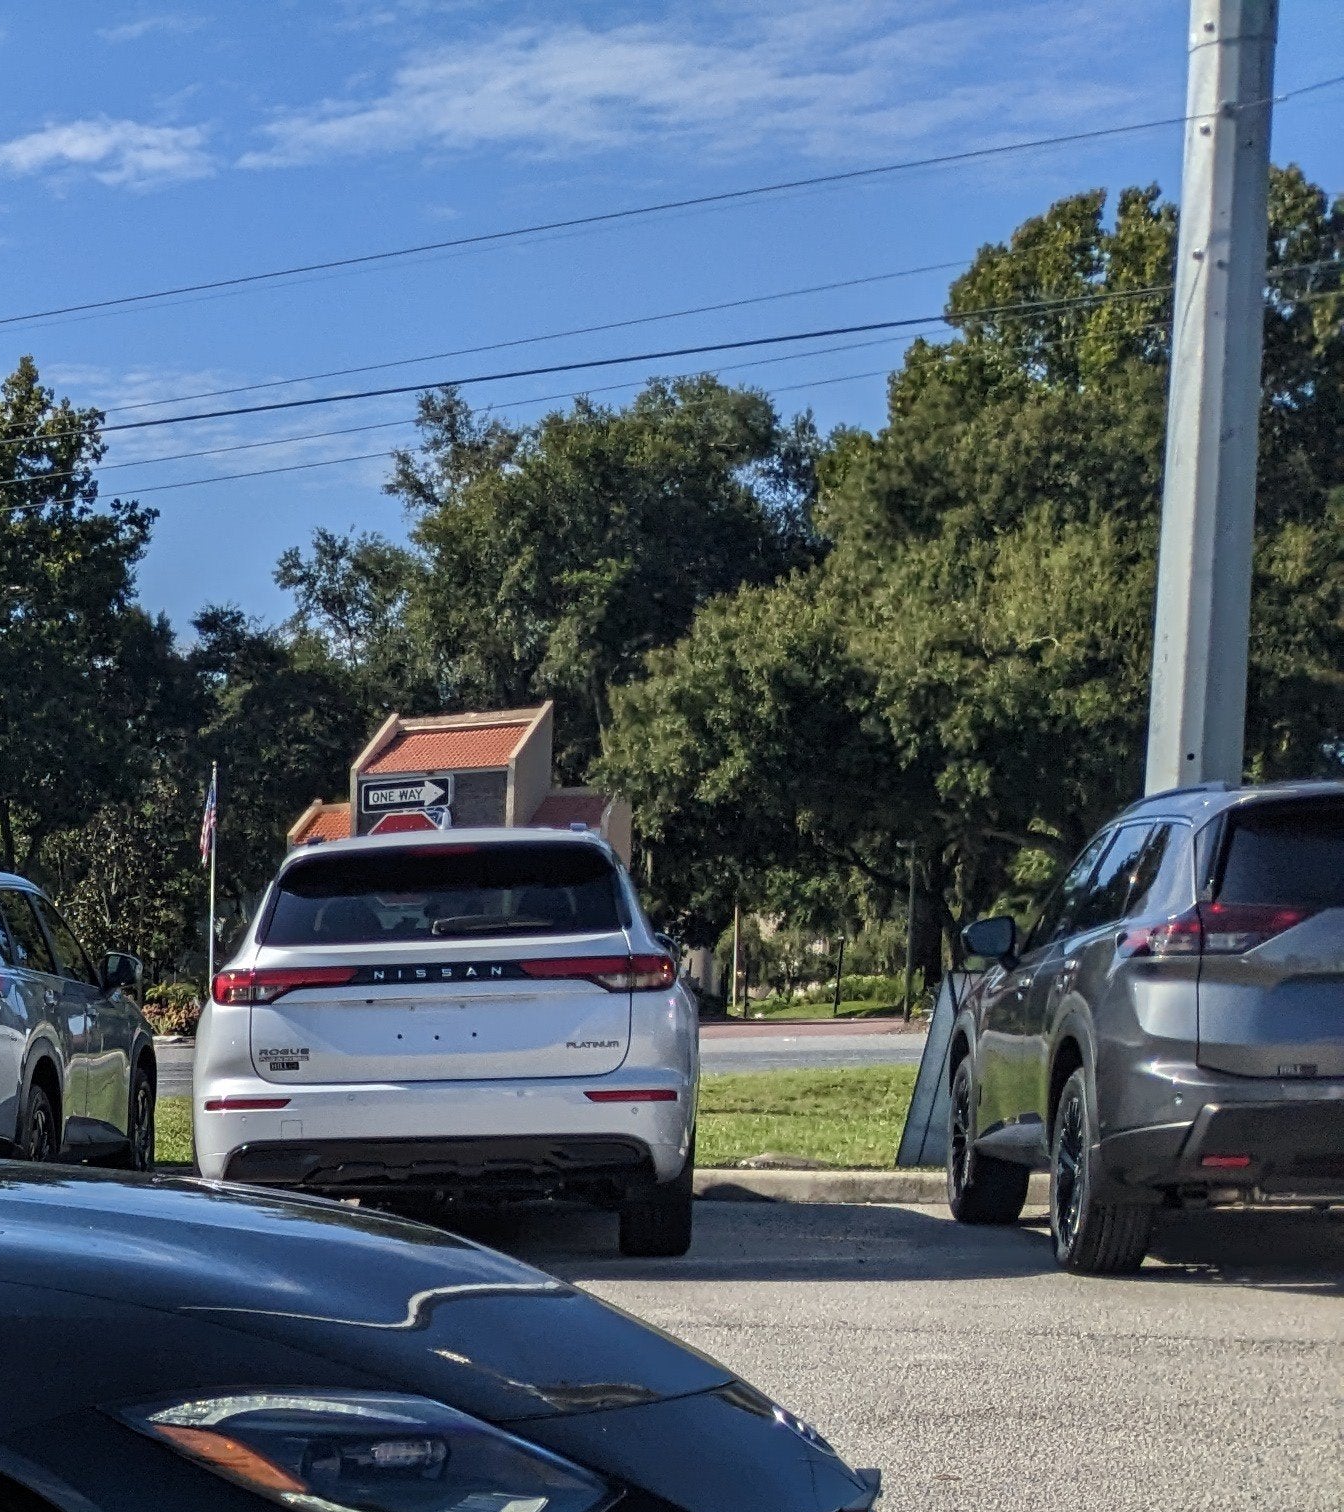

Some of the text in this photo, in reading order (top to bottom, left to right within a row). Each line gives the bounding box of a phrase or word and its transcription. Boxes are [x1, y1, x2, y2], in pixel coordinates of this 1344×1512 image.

[372, 788, 424, 803] ONE WAY
[373, 966, 502, 980] NISSAN
[565, 1040, 620, 1049] PLATINUM
[258, 1047, 310, 1056] ROGUE
